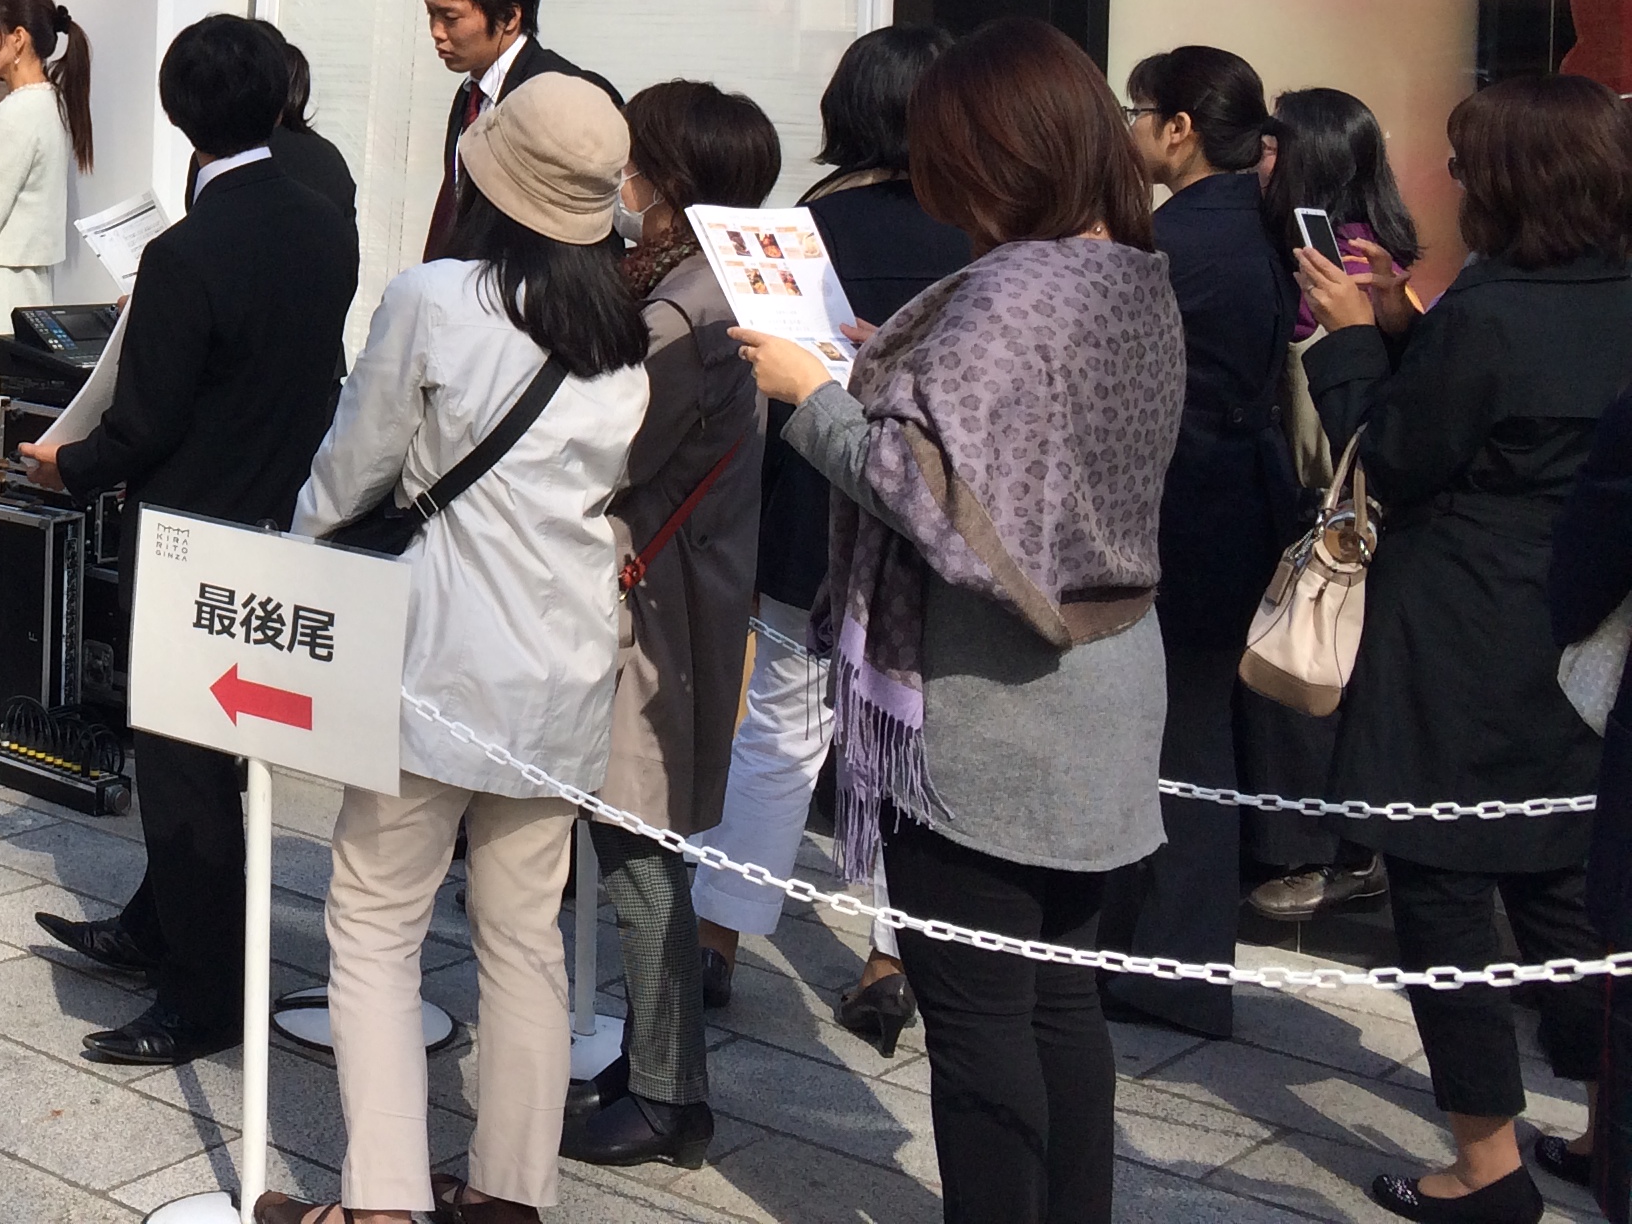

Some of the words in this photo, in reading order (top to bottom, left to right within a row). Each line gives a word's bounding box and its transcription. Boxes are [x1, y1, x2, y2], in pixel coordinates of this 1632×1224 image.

[156, 533, 188, 546] KIRA
[156, 541, 188, 554] RITO
[155, 549, 187, 562] GINZA
[193, 582, 335, 663] 最後尾
